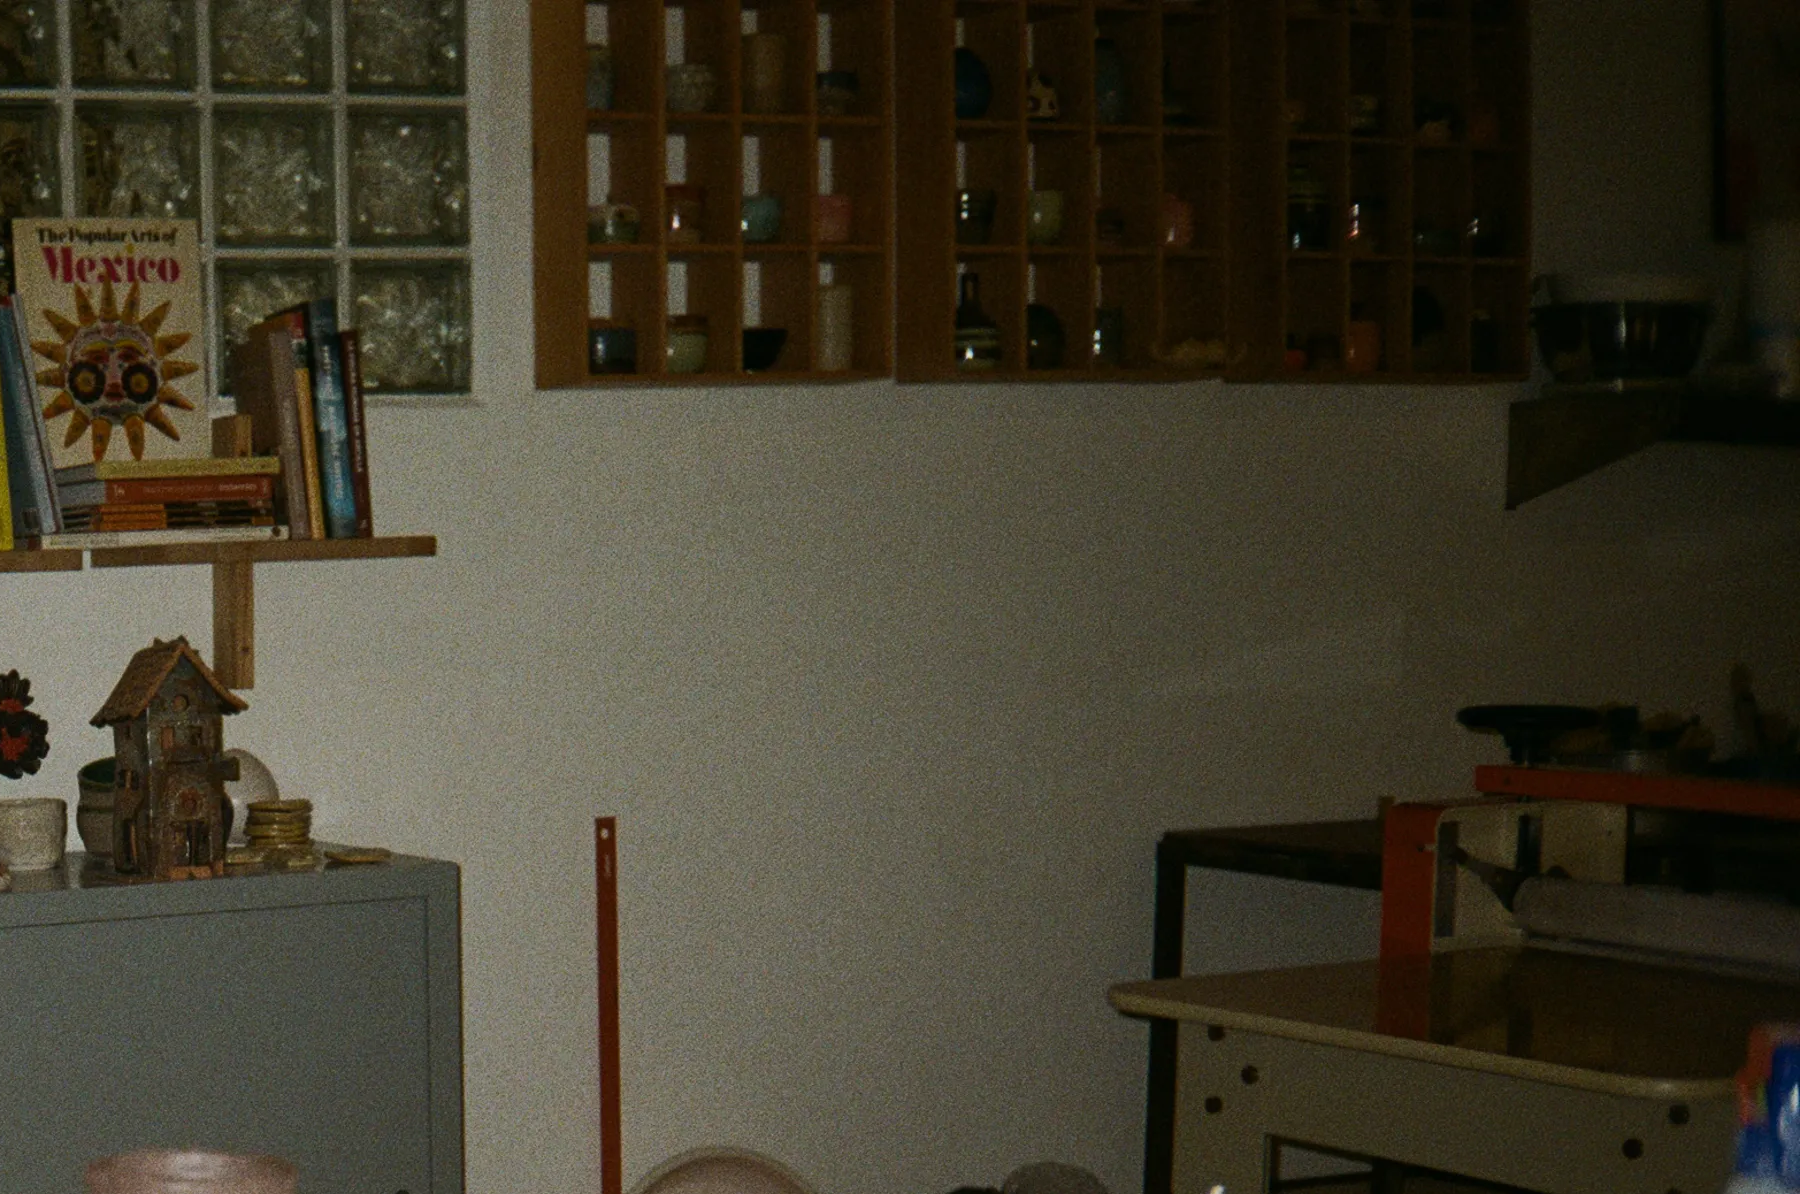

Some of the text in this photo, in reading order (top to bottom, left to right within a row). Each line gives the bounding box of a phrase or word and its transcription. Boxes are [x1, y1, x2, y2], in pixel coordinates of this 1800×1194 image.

[36, 227, 177, 247] The Popular Arts of
[41, 246, 181, 284] Mexico
